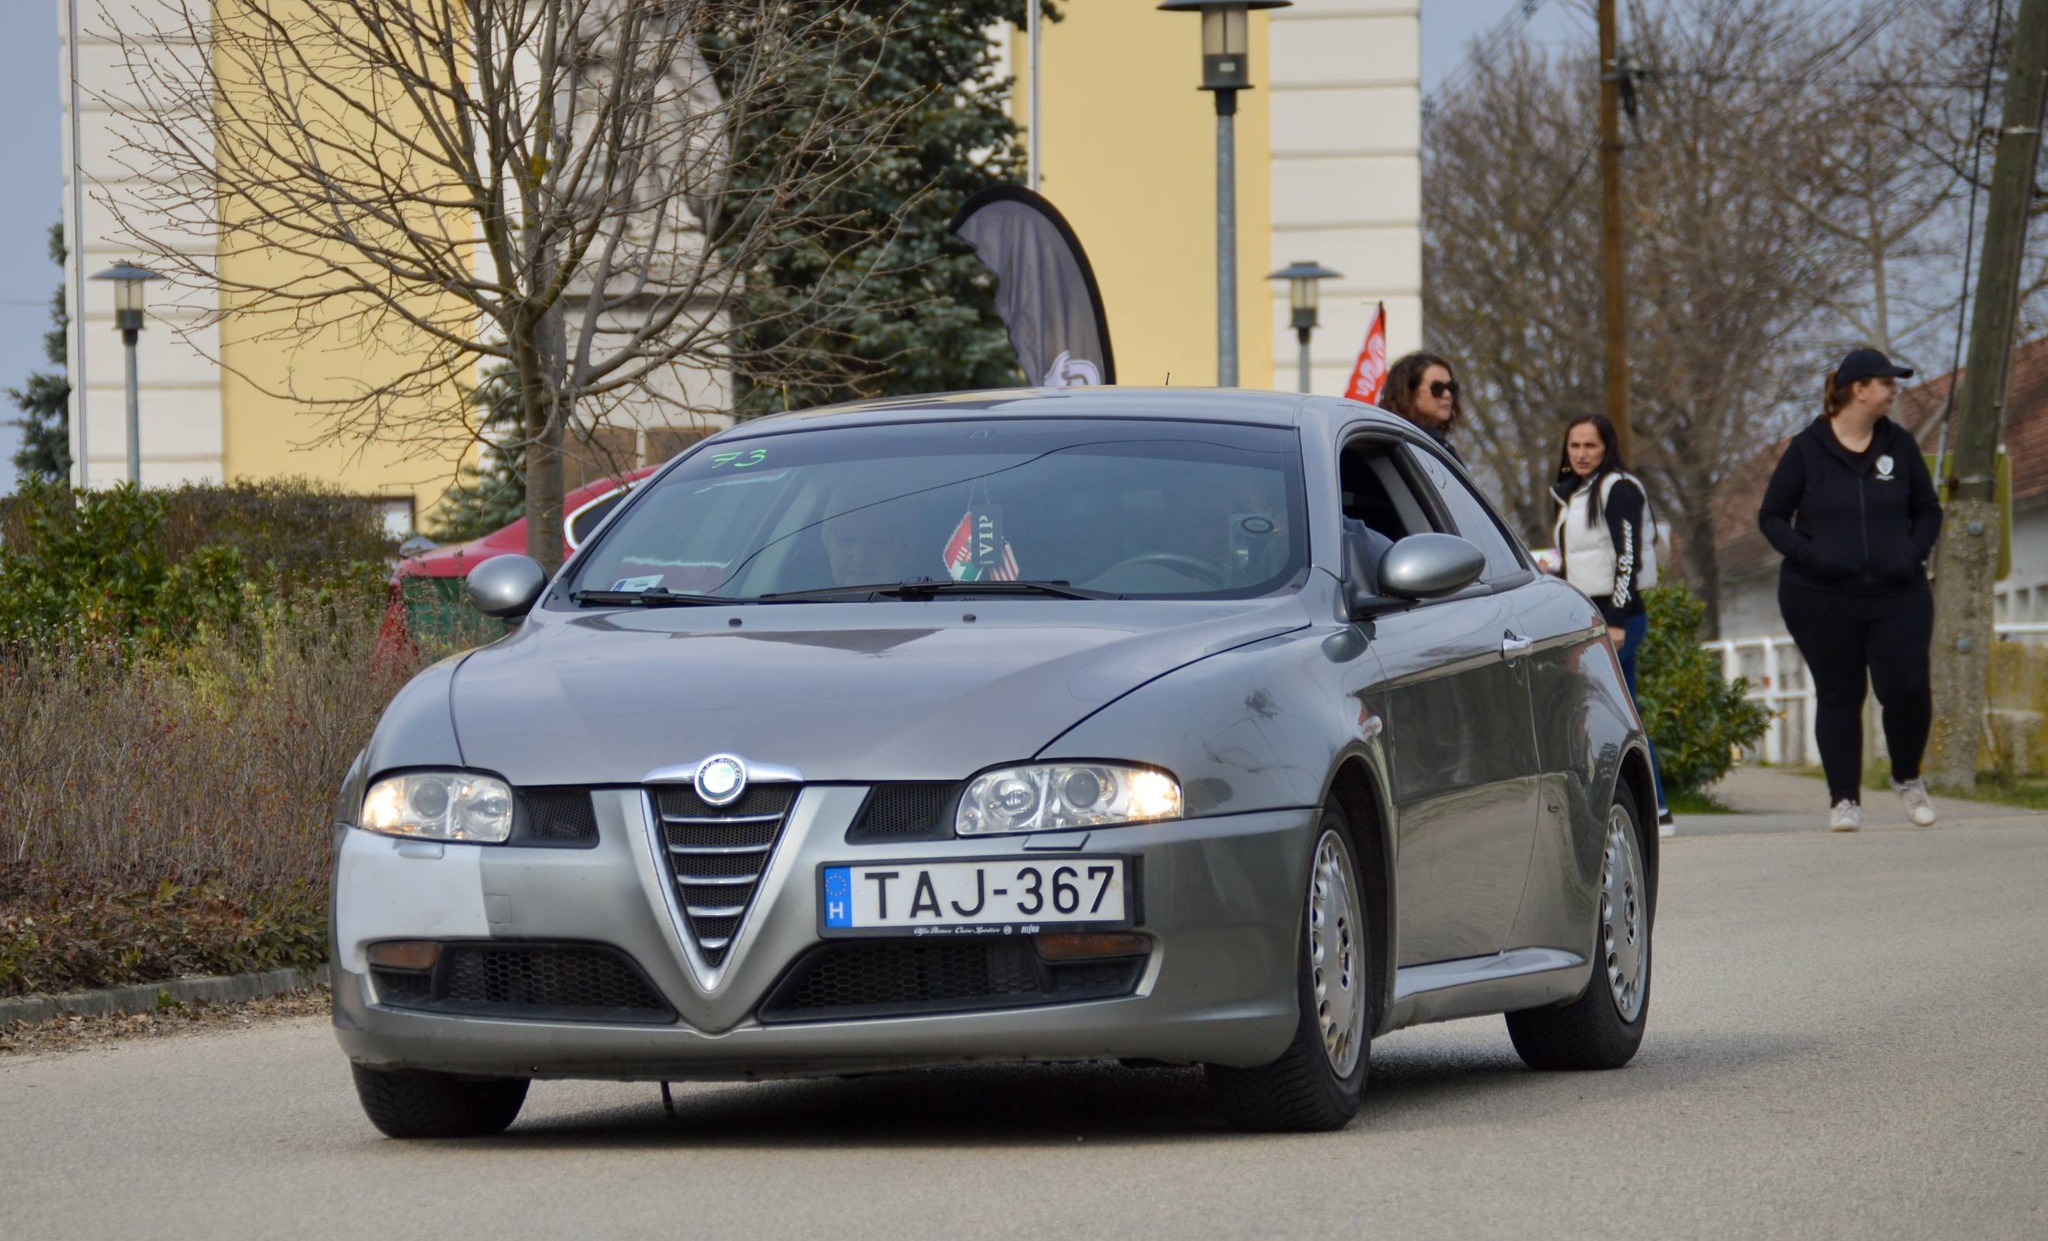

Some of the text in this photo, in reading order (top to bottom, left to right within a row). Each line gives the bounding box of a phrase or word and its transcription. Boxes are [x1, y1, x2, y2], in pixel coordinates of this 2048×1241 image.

[710, 448, 768, 469] 73
[979, 515, 994, 557] VIP
[864, 866, 1115, 919] TAJ-367
[829, 902, 844, 920] H
